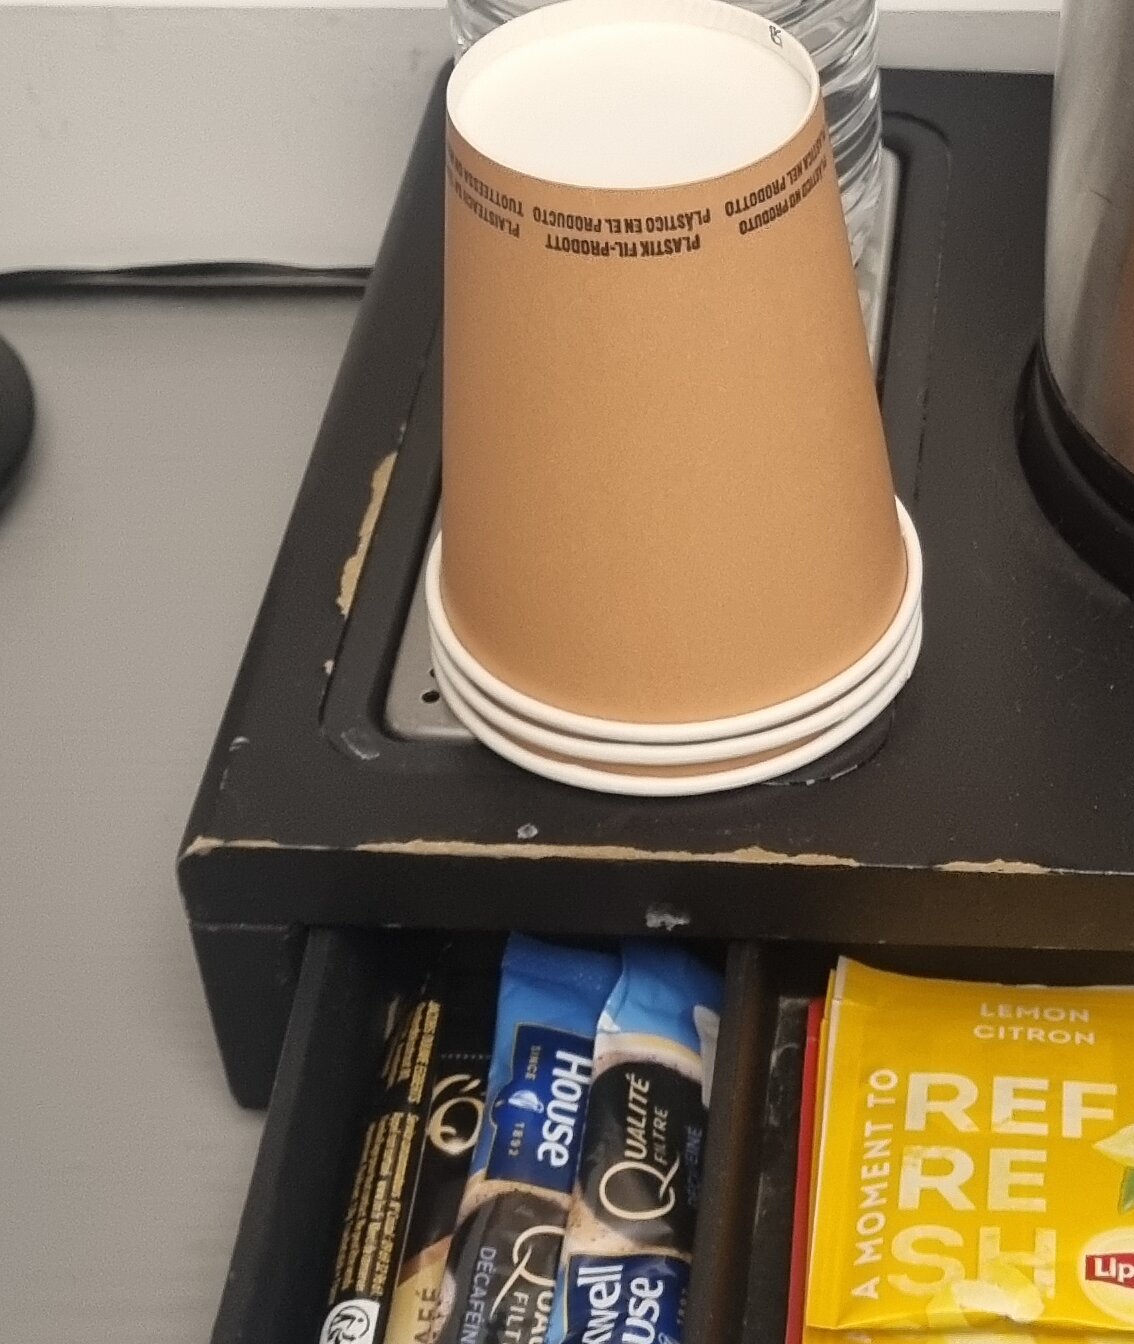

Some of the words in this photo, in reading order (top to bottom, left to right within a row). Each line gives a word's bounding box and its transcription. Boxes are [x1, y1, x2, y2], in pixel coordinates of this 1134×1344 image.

[787, 162, 802, 185] NEL
[725, 174, 787, 217] PRODOTTO
[531, 206, 601, 232] PRODUCTO
[603, 217, 621, 234] EL
[622, 217, 642, 234] EN
[644, 207, 711, 234] PLÁSTICO
[739, 198, 789, 235] PRODUTO
[544, 232, 637, 257] FIL-PRODOTT
[640, 233, 700, 258] PLASTIK
[979, 1002, 1090, 1023] LEMON
[973, 1024, 1095, 1046] CITRON
[526, 1044, 542, 1081] SINCE
[868, 1067, 899, 1107] TO
[537, 1049, 593, 1168] House
[905, 1072, 1118, 1139] REF
[508, 1121, 525, 1157] 1892
[654, 1107, 668, 1166] FILTRE
[854, 1120, 894, 1266] MOMENT
[898, 1144, 1048, 1213] RE
[888, 1224, 1057, 1300] SH
[851, 1277, 879, 1300] A
